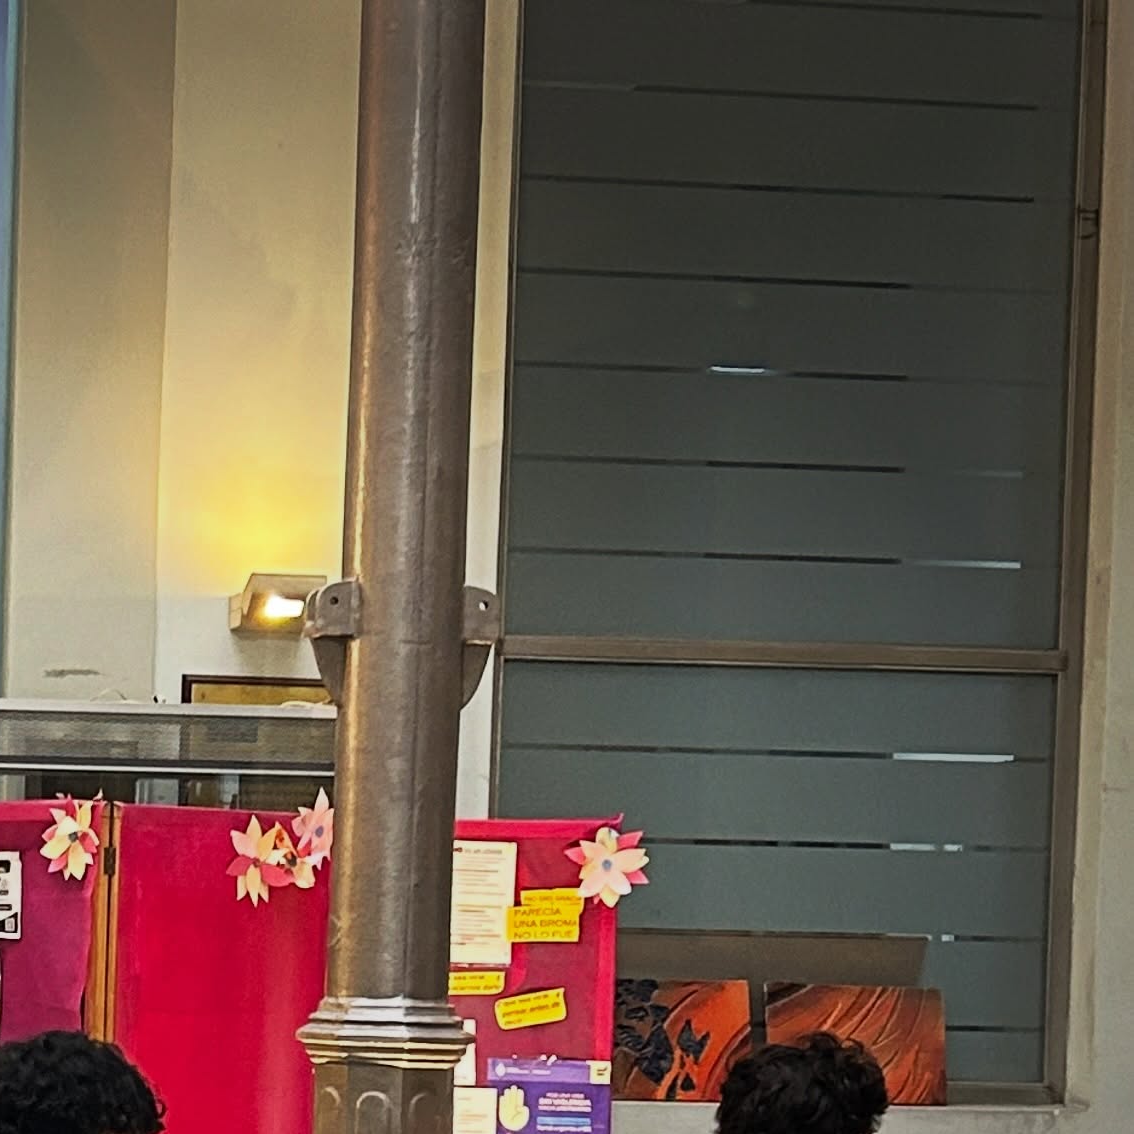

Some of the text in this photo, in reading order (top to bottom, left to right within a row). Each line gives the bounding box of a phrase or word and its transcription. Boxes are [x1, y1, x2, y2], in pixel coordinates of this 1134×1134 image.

[513, 919, 577, 929] UNA BROMA
[513, 931, 531, 939] NO
